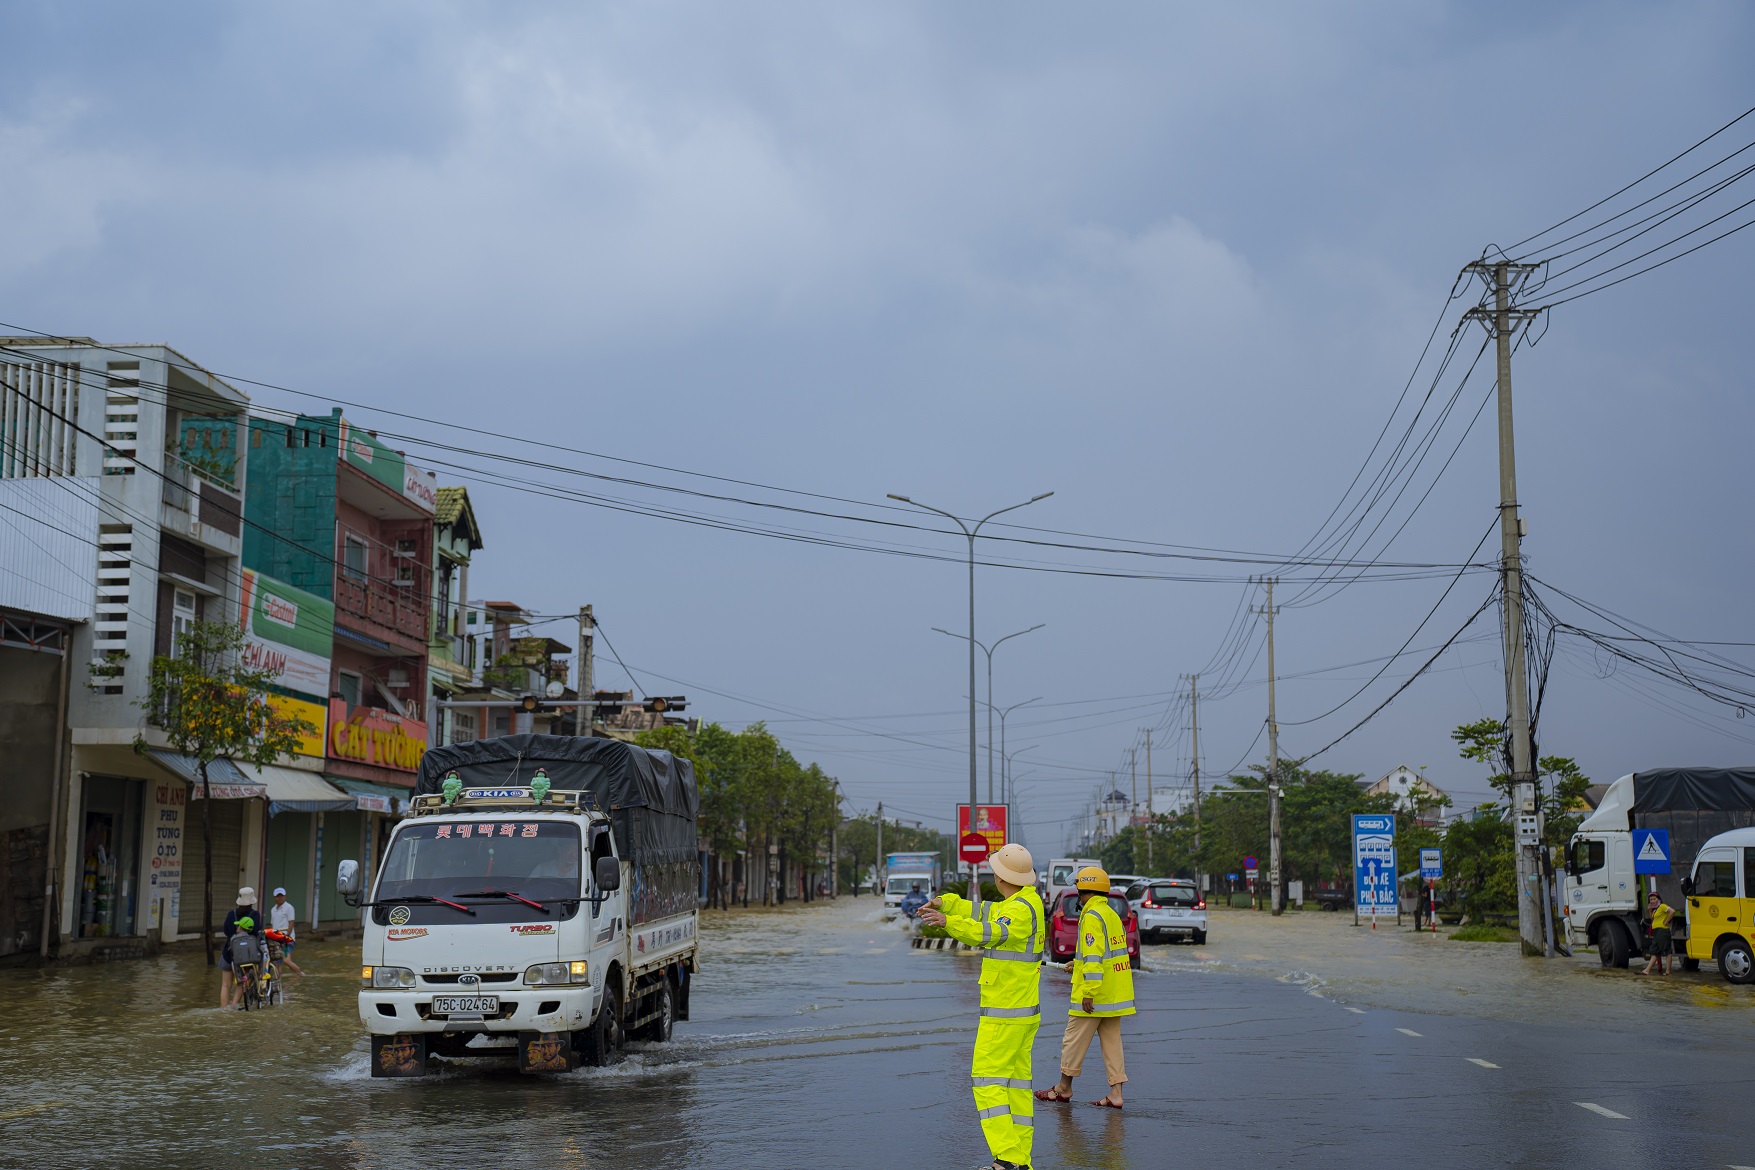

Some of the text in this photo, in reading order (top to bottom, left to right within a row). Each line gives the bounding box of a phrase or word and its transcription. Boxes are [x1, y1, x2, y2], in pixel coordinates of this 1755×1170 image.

[262, 649, 287, 676] ANH
[333, 715, 371, 760] CÁT
[373, 724, 427, 769] TƯỜNG
[169, 786, 185, 806] ANH
[160, 809, 178, 825] PHỤ
[1380, 872, 1390, 886] XE
[388, 927, 429, 936] KIA MOTORS
[509, 924, 553, 933] TURBO
[423, 965, 516, 973] DISCOVERY
[436, 998, 496, 1012] 75C-024.64
